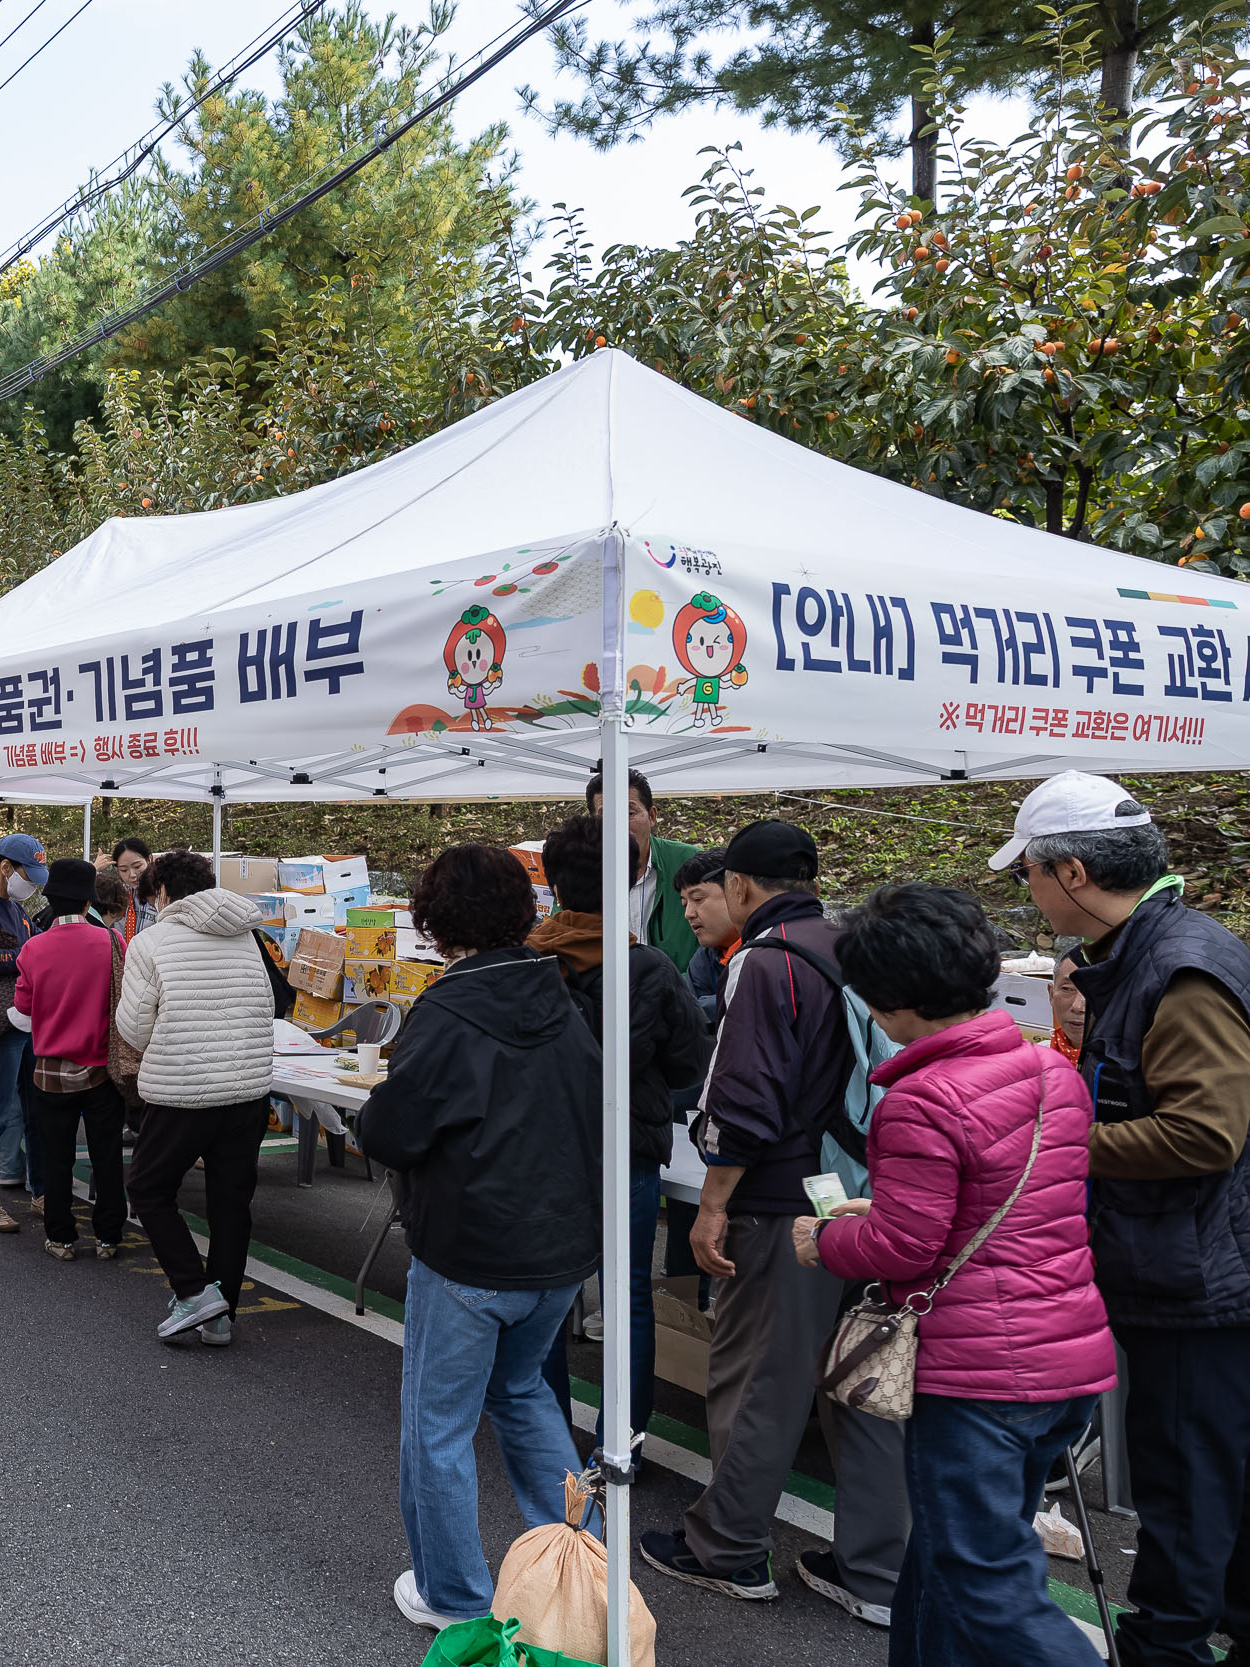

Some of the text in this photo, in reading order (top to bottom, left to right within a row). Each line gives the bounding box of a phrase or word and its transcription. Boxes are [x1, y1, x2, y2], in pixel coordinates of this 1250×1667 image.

[680, 556, 723, 576] 행복광진
[238, 609, 365, 704] 배부
[772, 583, 916, 682] [안내]
[930, 601, 1061, 689] 먹거리
[1065, 616, 1145, 697] 쿠폰
[1158, 623, 1233, 703] 교환
[965, 702, 1026, 735] 먹거리
[1029, 708, 1069, 738] 쿠폰
[1071, 709, 1129, 742] 교환은
[1132, 713, 1205, 746] 여기서!!!
[3, 744, 37, 768] 기념품
[40, 741, 67, 765] 배부
[94, 734, 125, 762] 행사
[128, 732, 160, 759] 종료
[163, 726, 200, 757] 후!!!
